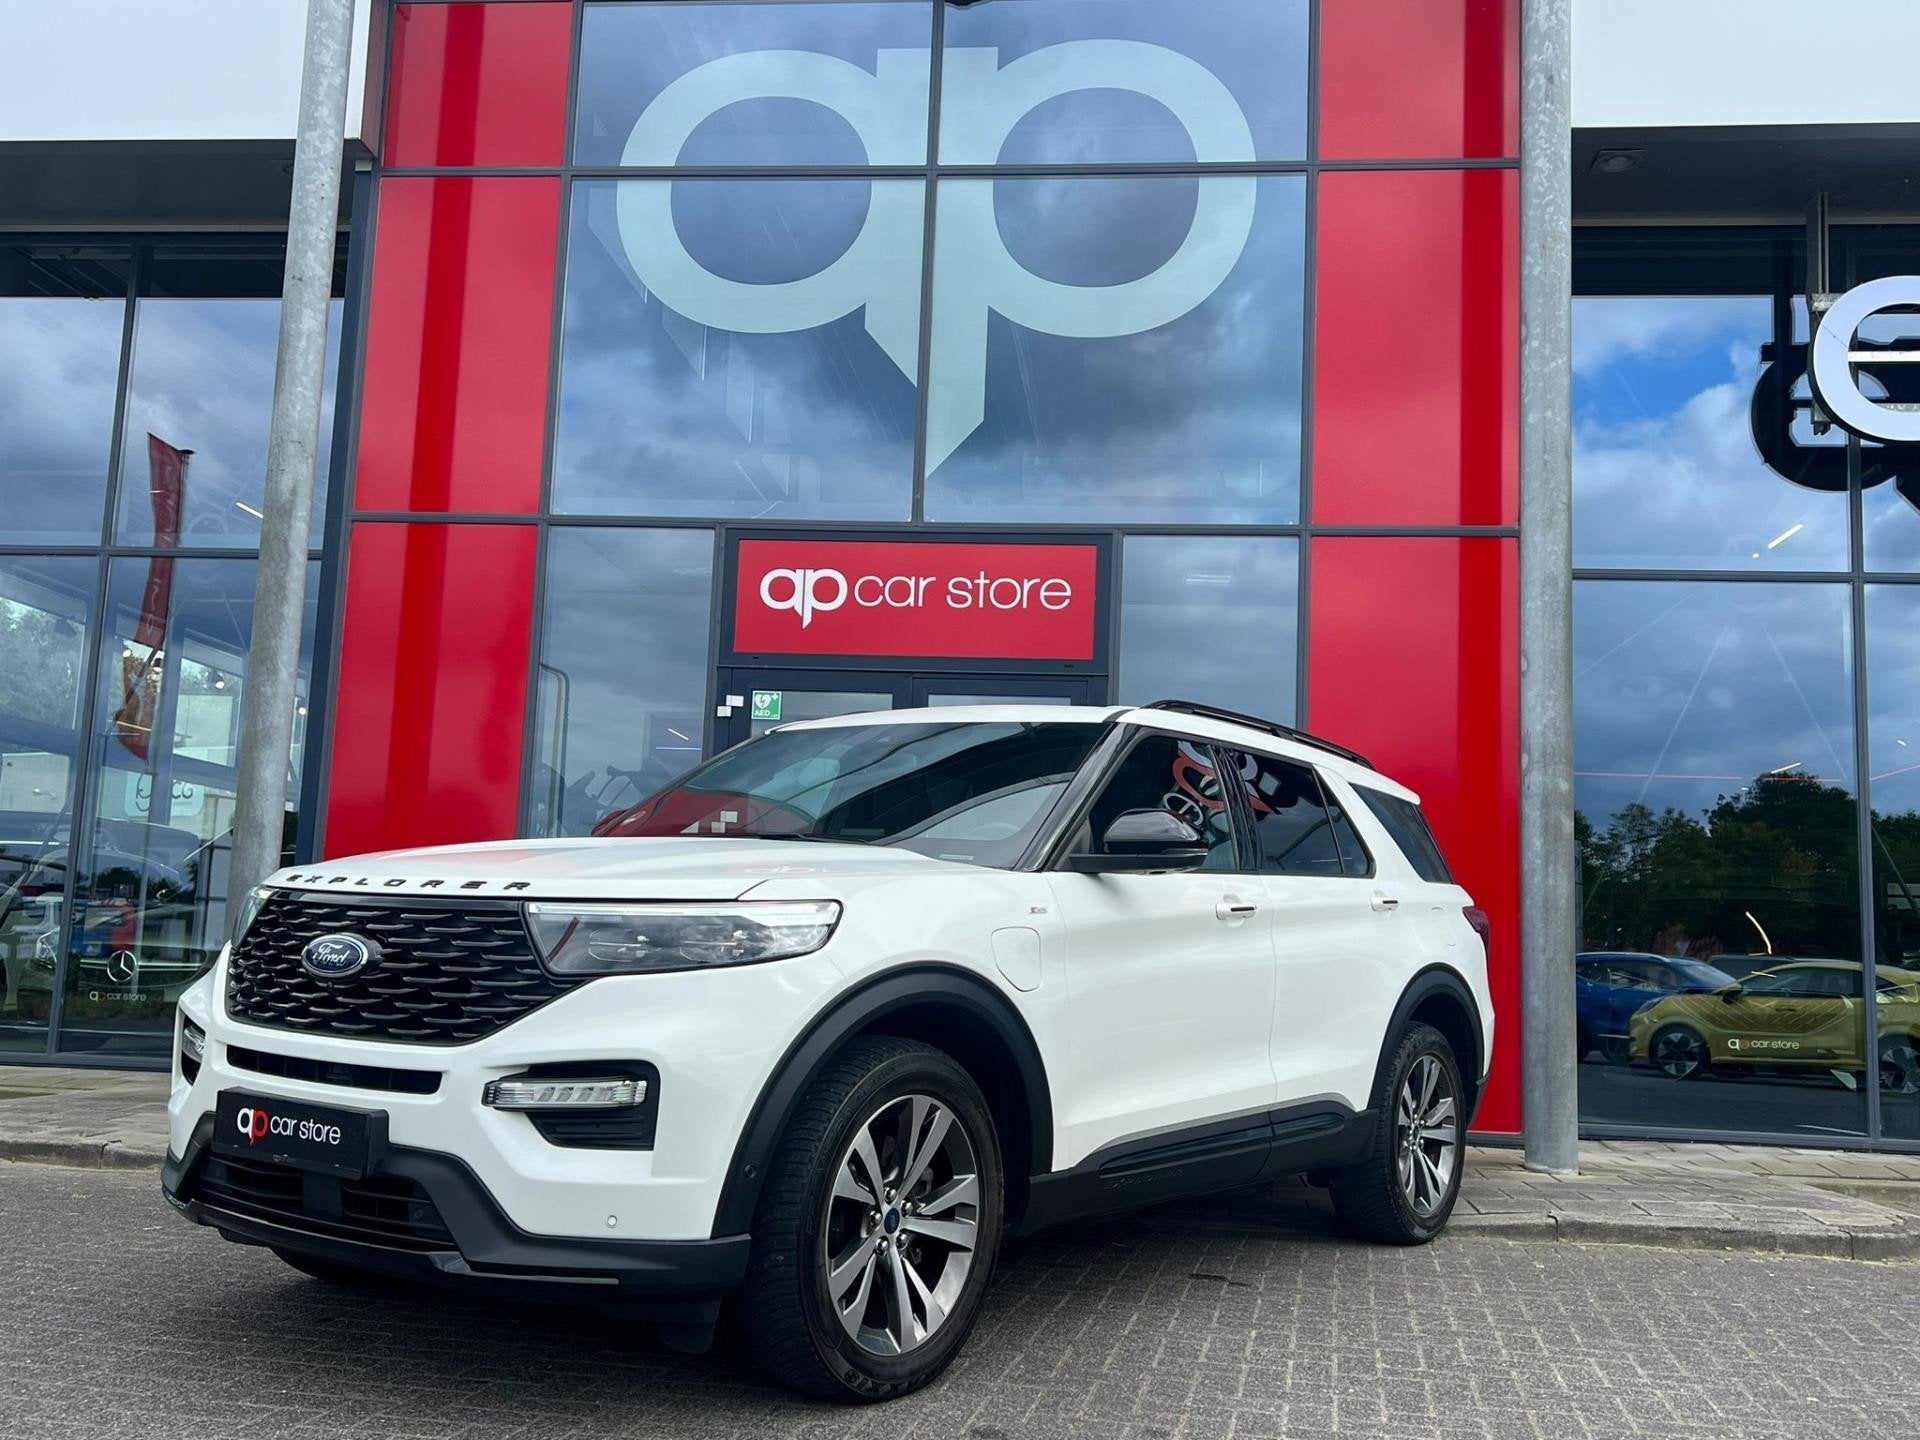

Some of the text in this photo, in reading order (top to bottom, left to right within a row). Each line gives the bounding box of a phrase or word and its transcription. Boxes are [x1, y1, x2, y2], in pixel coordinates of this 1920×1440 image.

[853, 575, 937, 607] car
[946, 571, 1072, 610] store
[754, 709, 771, 717] AED
[285, 874, 532, 891] EXPLORER
[312, 942, 351, 964] Ford
[106, 993, 122, 1001] car
[1751, 1040, 1770, 1048] car
[1771, 1040, 1800, 1050] store
[270, 1115, 298, 1137] car
[298, 1118, 342, 1145] store
